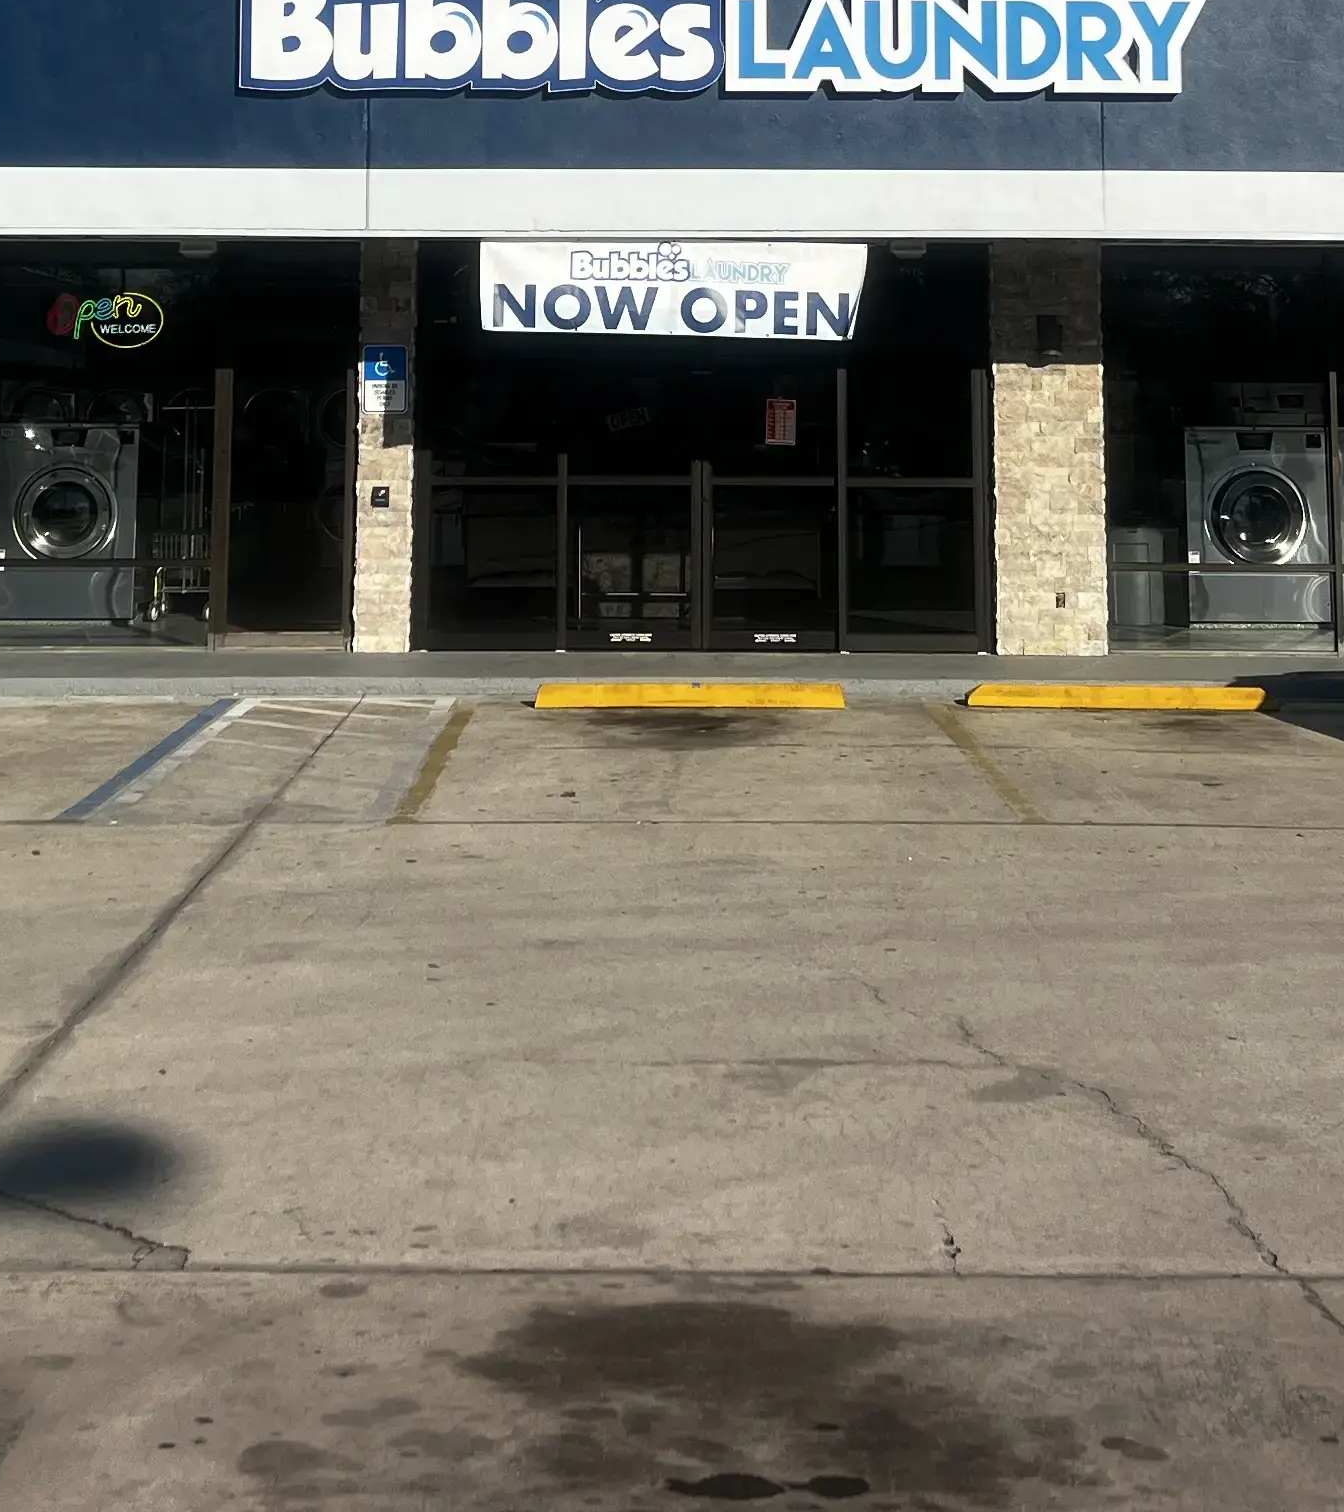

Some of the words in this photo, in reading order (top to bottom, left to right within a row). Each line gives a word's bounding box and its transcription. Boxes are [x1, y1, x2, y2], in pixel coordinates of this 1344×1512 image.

[570, 247, 691, 281] Bubbles
[691, 259, 790, 284] LAUNDRY
[493, 283, 658, 330] NOW
[680, 287, 853, 336] OPEN
[99, 323, 157, 334] WELCOME
